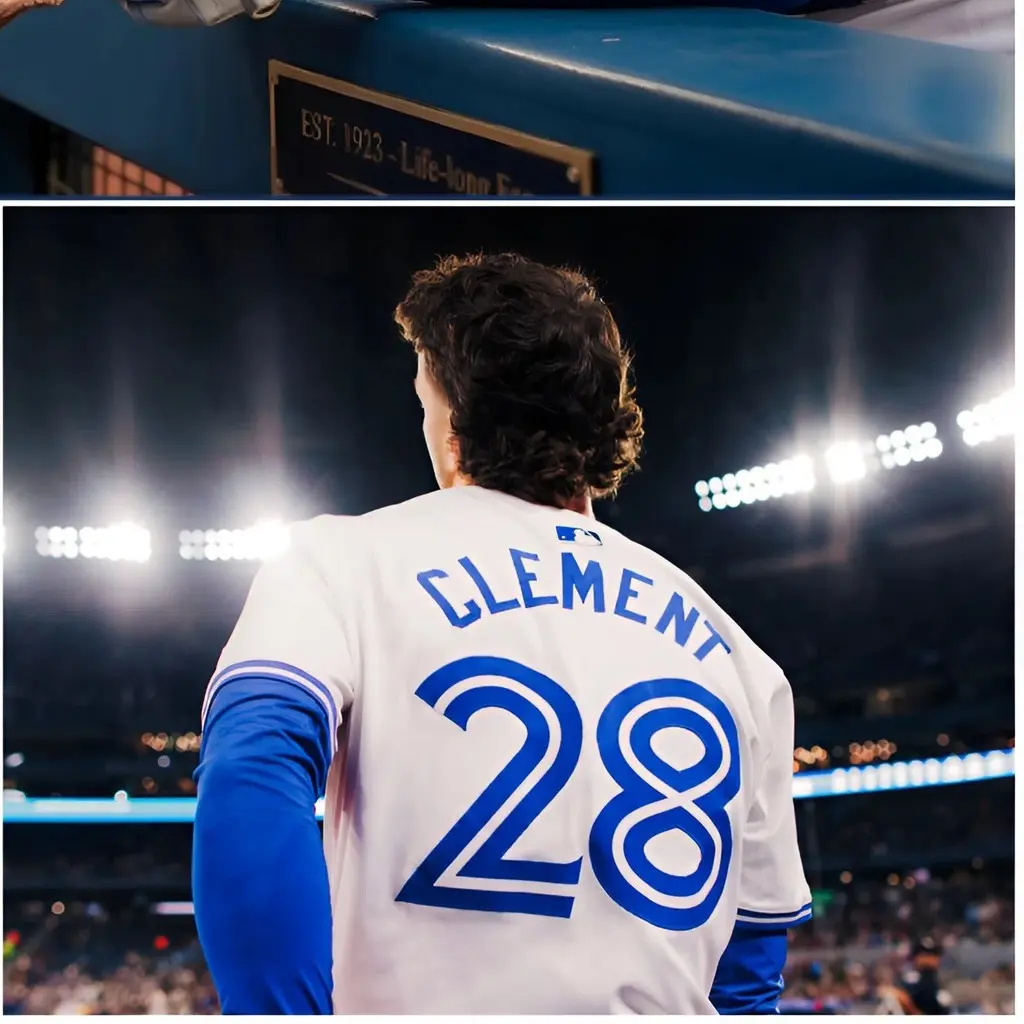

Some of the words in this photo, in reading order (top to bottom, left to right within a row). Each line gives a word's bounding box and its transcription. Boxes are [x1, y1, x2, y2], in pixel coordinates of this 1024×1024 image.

[301, 108, 337, 147] EST.
[343, 123, 383, 163] 1923
[417, 548, 731, 662] CLEMENT
[394, 656, 741, 931] 28
